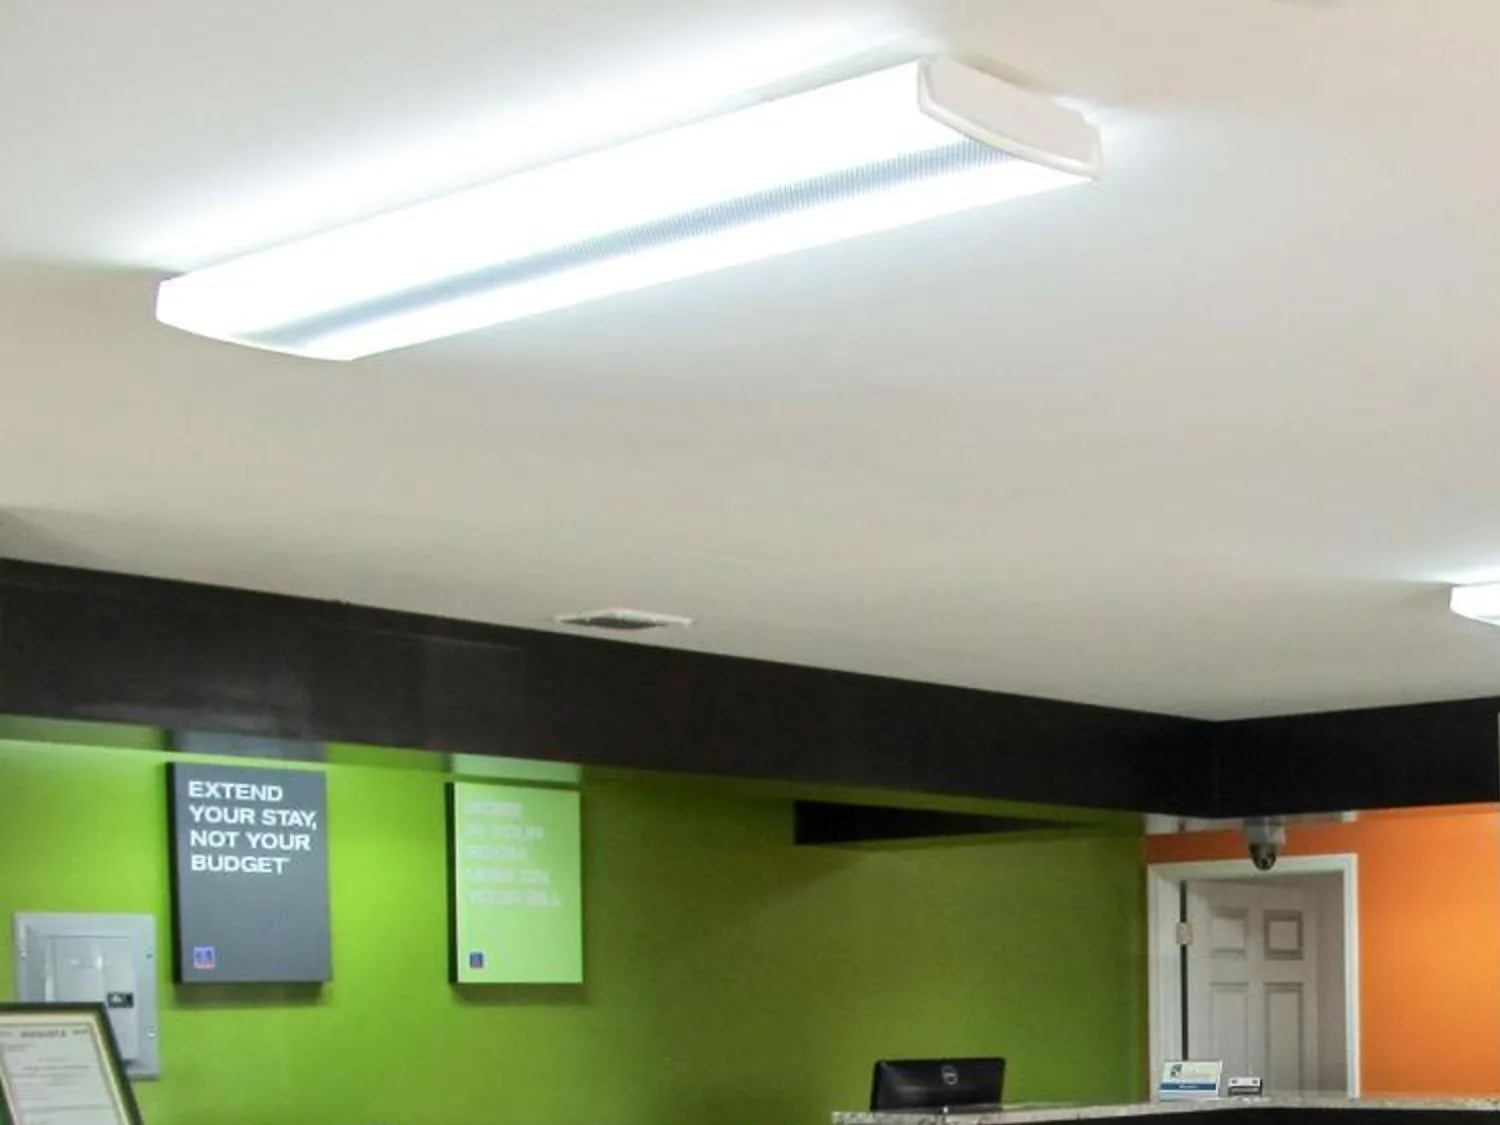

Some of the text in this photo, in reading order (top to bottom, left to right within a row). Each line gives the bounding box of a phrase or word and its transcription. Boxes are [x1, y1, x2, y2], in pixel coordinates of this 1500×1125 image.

[188, 780, 283, 802] EXTEND
[188, 804, 318, 831] YOUR STAY,
[190, 829, 312, 851] NOT YOUR
[191, 854, 290, 875] BUDGET
